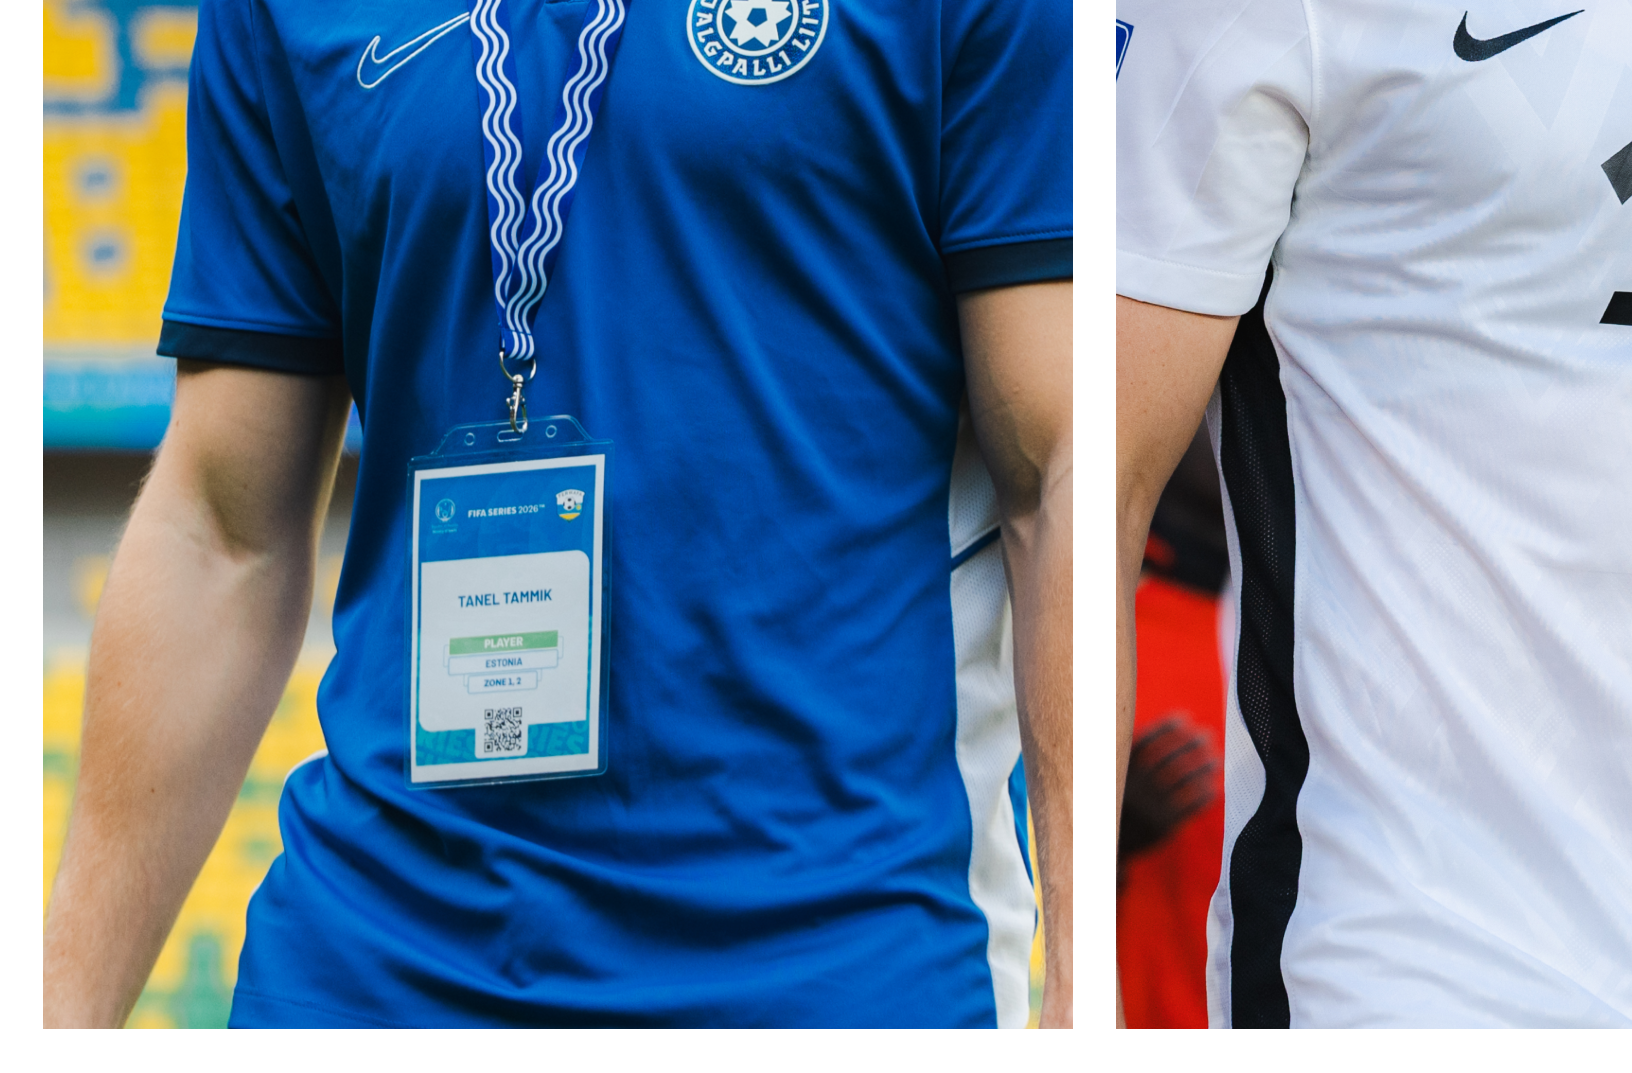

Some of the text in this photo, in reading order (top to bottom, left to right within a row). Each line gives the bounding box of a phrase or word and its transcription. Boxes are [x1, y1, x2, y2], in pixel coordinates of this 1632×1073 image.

[467, 509, 487, 518] FIFA
[488, 507, 517, 517] SERIES
[458, 589, 552, 608] TANEL TAMMIK
[484, 636, 524, 649] PLAYER
[485, 658, 523, 668] ESTONIA
[484, 678, 507, 688] ZONE
[516, 676, 522, 685] 2
